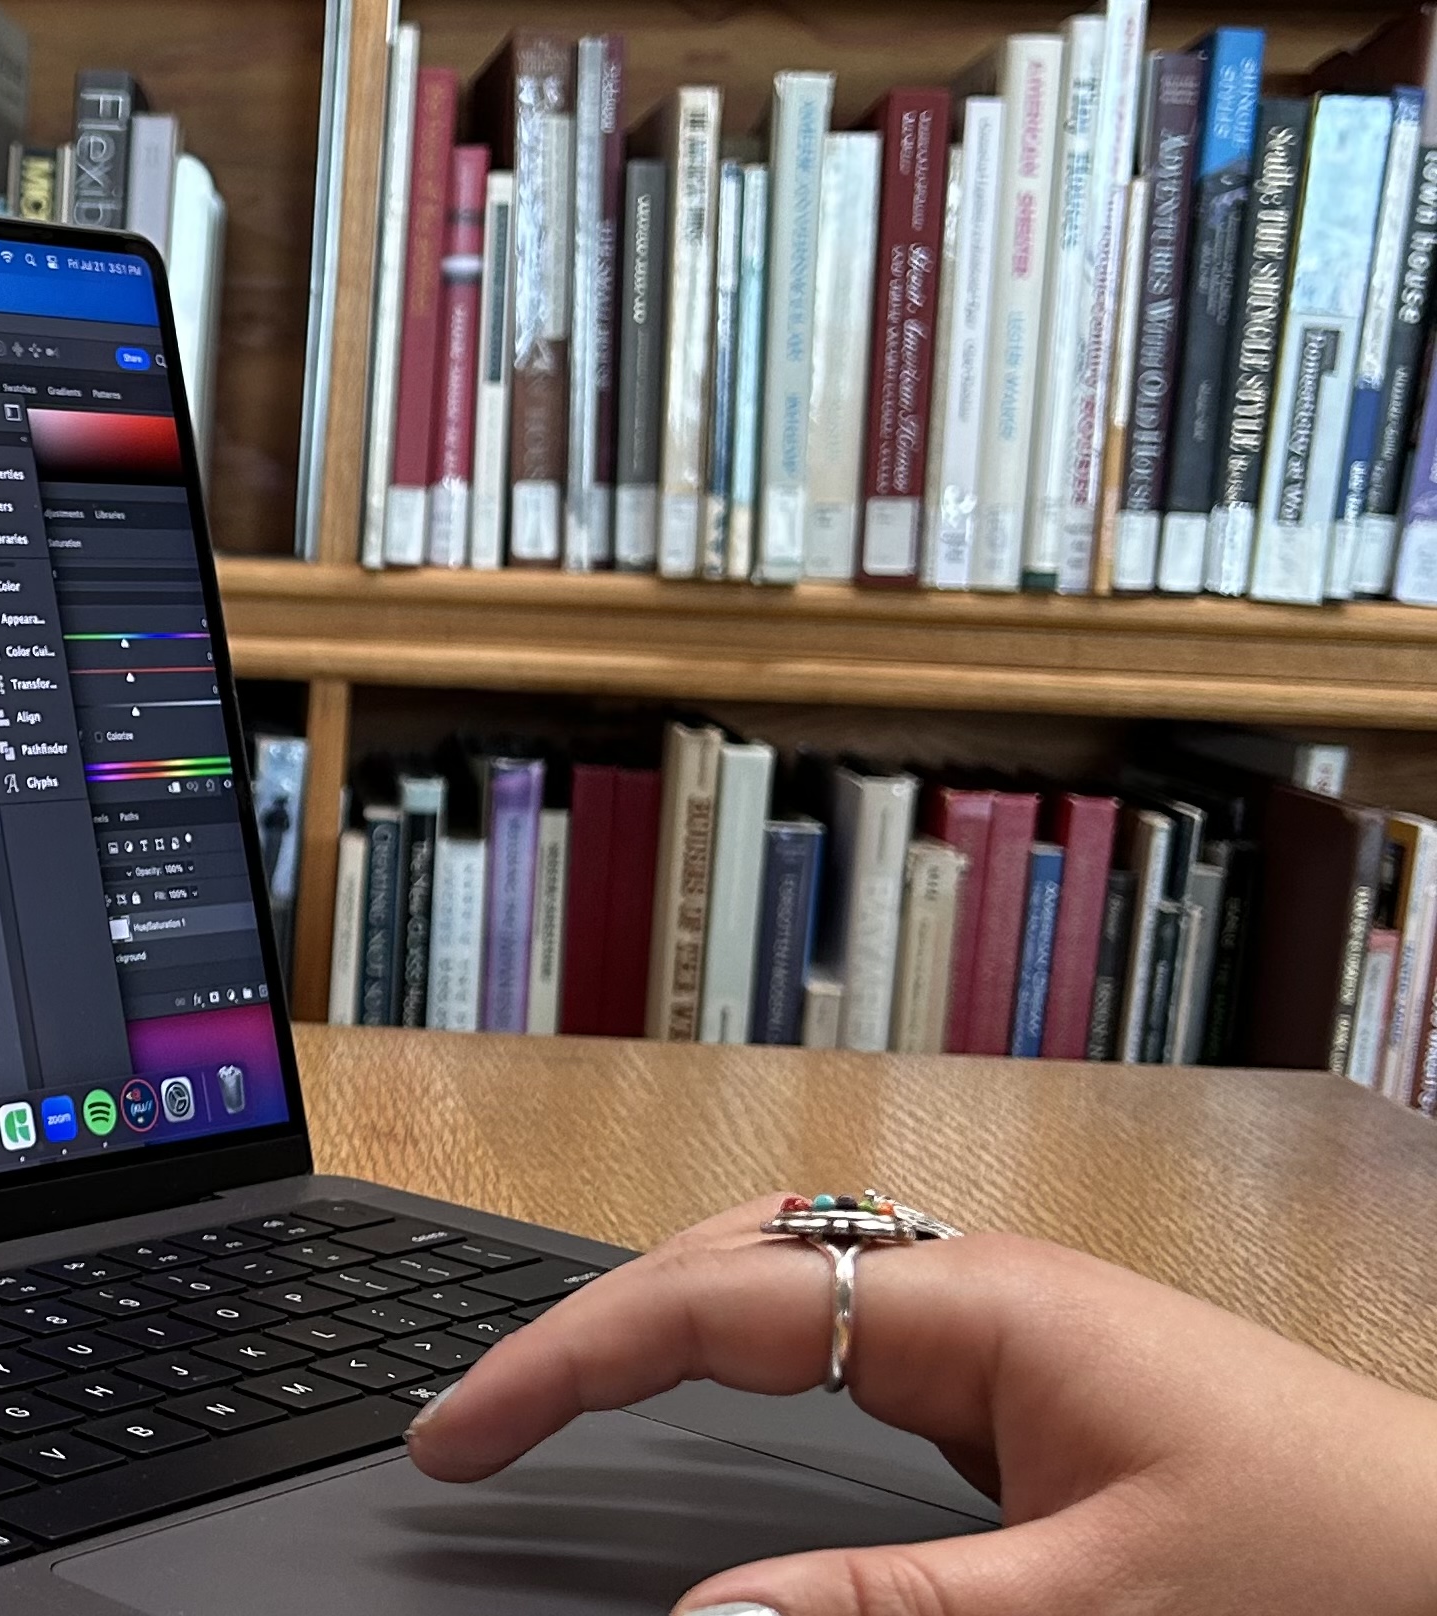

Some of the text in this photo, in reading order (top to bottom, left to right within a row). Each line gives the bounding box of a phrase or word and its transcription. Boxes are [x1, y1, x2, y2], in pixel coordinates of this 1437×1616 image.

[5, 645, 31, 658] Color
[16, 710, 41, 725] Align
[21, 742, 68, 757] Pathfinder
[27, 775, 59, 790] Glyphs
[47, 1113, 71, 1126] zoom
[45, 1316, 68, 1324] 8
[311, 1330, 336, 1339] L
[67, 1344, 93, 1355] U
[239, 1346, 266, 1358] K
[171, 1365, 189, 1376] J
[84, 1385, 114, 1397] H
[281, 1382, 313, 1395] M
[5, 1407, 30, 1418] G
[206, 1403, 236, 1416] N
[126, 1426, 154, 1438] B
[39, 1447, 67, 1460] V
